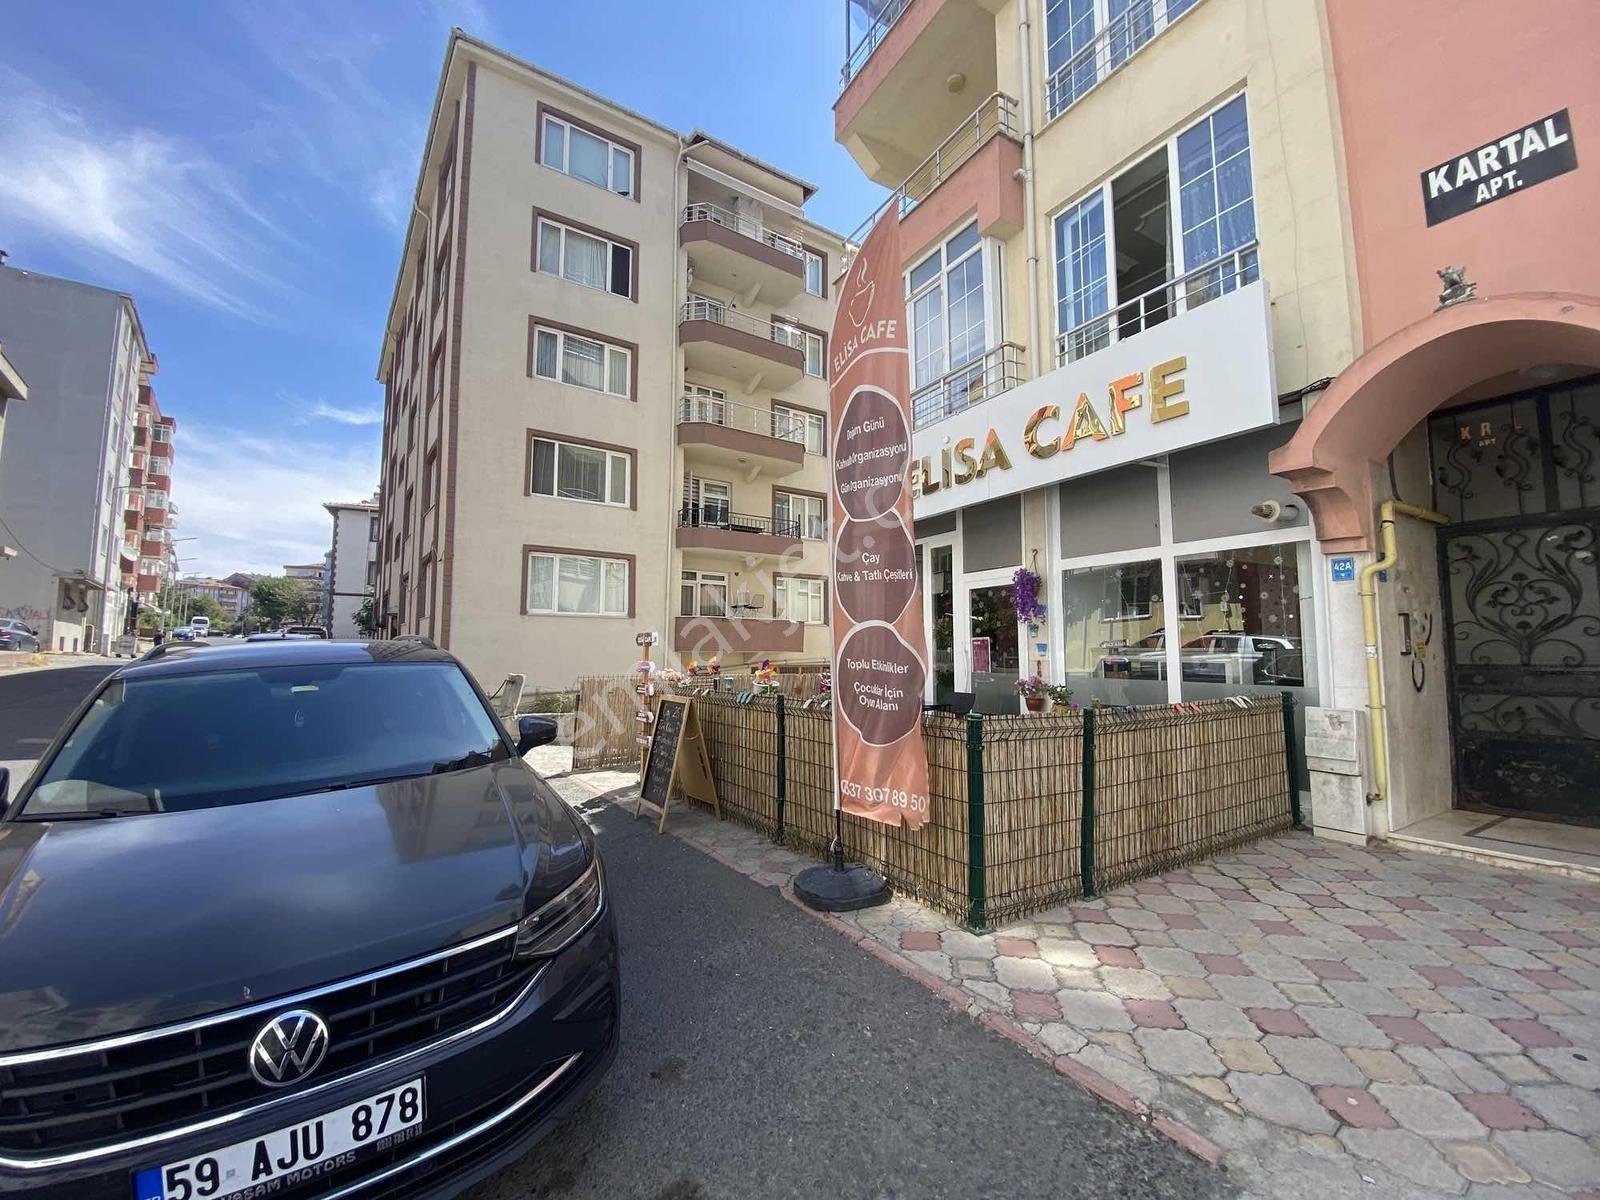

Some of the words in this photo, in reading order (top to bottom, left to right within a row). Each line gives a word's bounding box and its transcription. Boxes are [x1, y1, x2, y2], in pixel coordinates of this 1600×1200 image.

[1428, 118, 1568, 198] KARTAL
[1476, 169, 1523, 203] APT.
[861, 320, 897, 344] CAFE
[1023, 356, 1190, 459] CAFE
[863, 416, 885, 433] Günü
[853, 442, 907, 464] rganizasyonu
[862, 552, 880, 566] Çay
[1334, 562, 1351, 571] 42A
[854, 571, 861, 582] &
[862, 569, 882, 581] Tatlı
[846, 658, 870, 671] Toplu
[884, 684, 904, 700] İçin
[875, 698, 899, 711] Alanı
[892, 789, 908, 808] 89
[910, 794, 926, 813] 50
[166, 1156, 220, 1200] 59
[251, 1120, 325, 1181] AJU
[351, 1087, 419, 1142] 878
[286, 1151, 357, 1186] MOTORS
